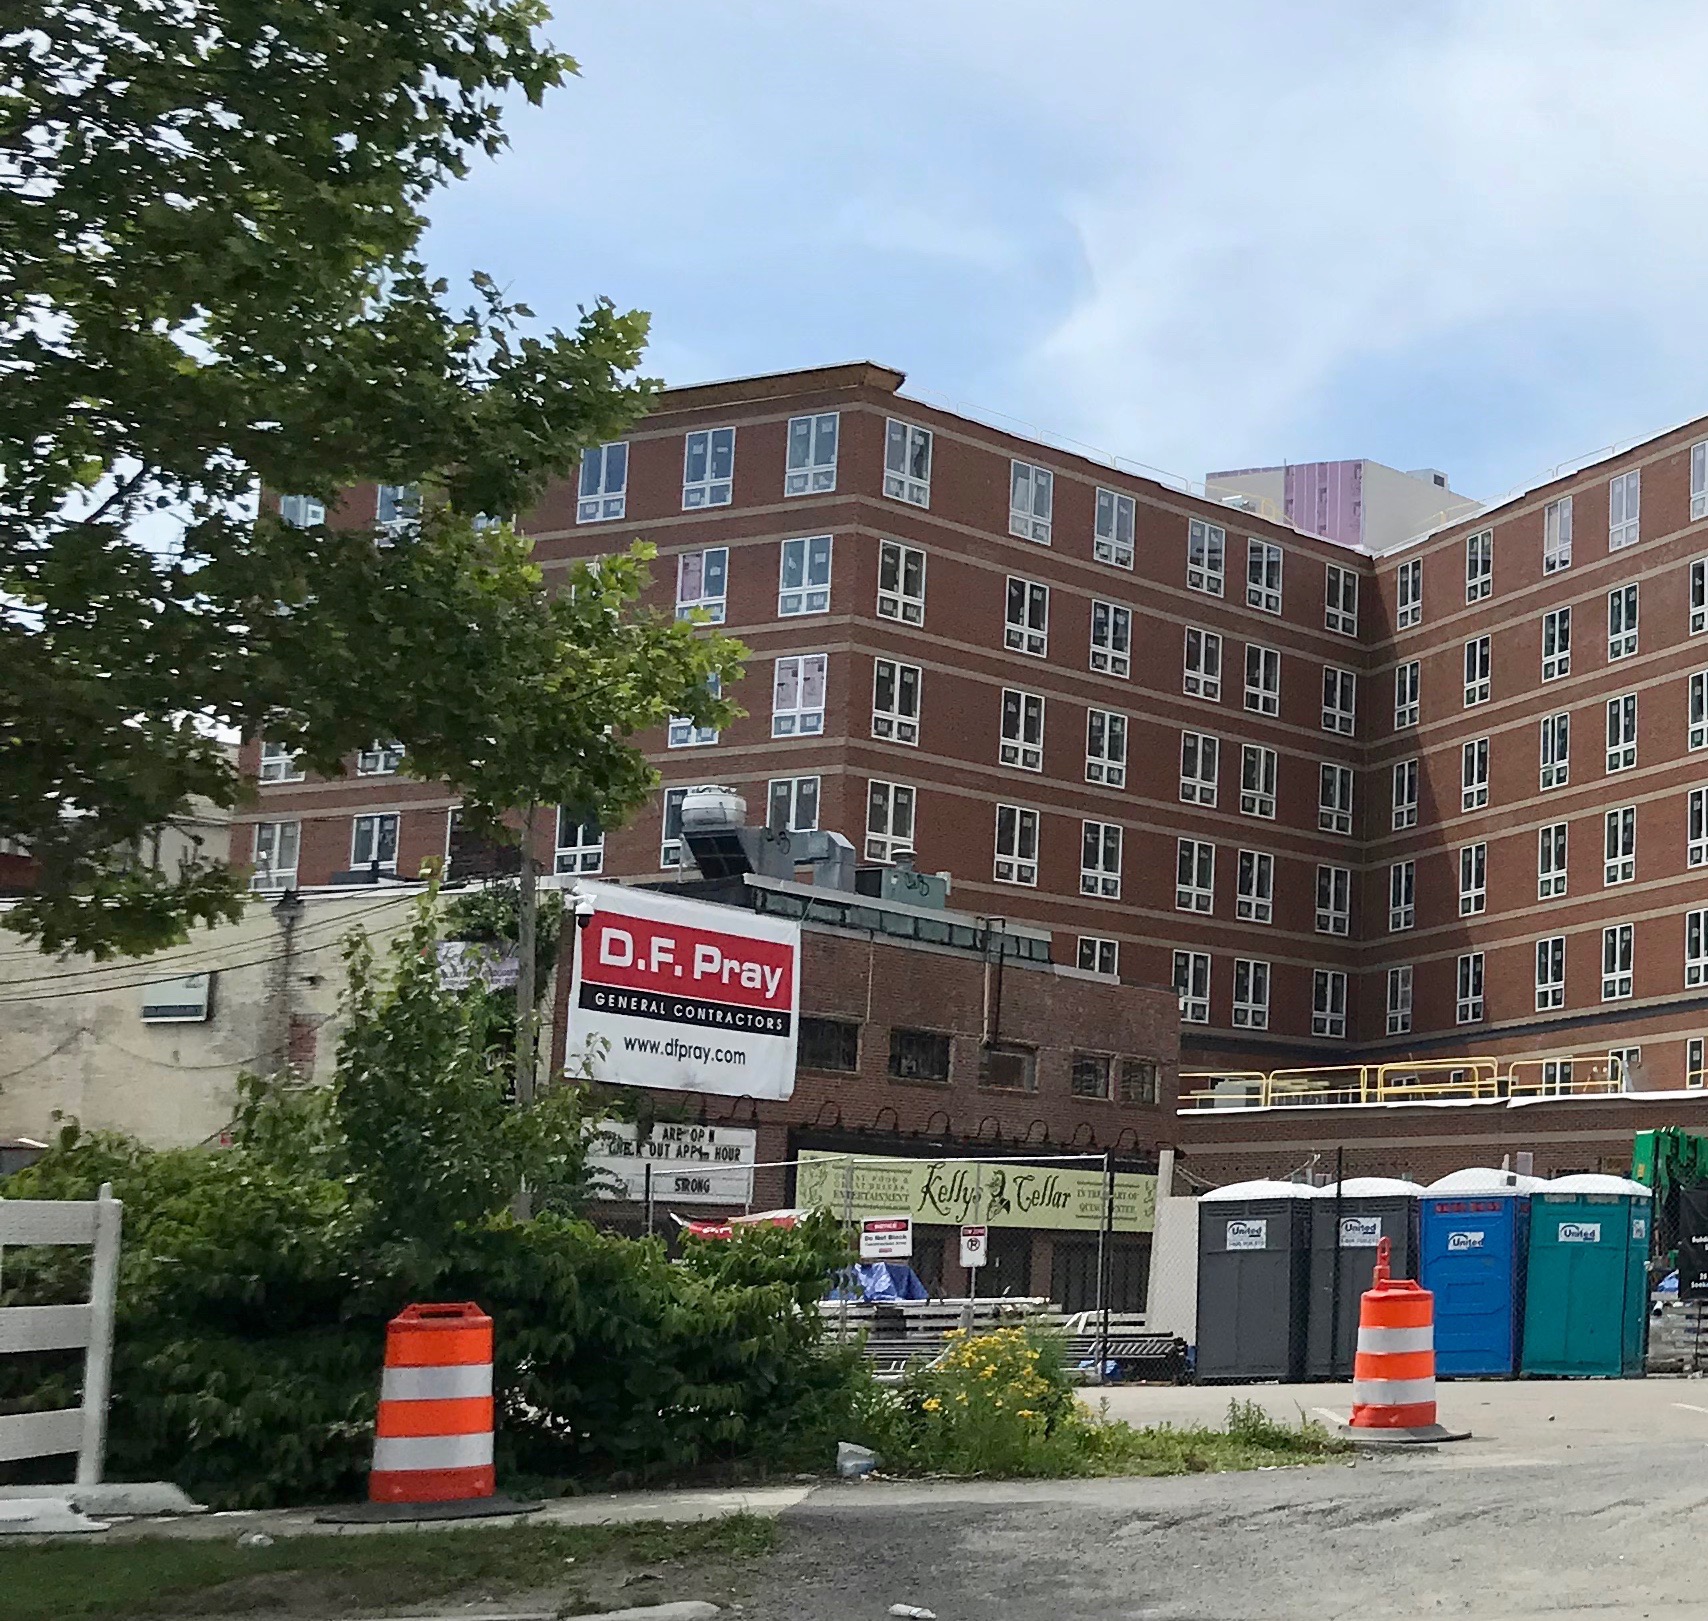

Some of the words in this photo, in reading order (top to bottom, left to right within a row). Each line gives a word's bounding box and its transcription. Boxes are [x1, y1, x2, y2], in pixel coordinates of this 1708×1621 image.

[600, 926, 682, 977] D.F.
[693, 943, 783, 999] Pray
[595, 992, 666, 1015] GENERAL
[673, 1004, 783, 1031] CONTRACTORS
[624, 1036, 746, 1065] www.dfpray.com
[662, 1126, 682, 1141] ARE
[649, 1142, 670, 1158] OUT
[714, 1146, 741, 1162] HOUR
[1013, 1174, 1071, 1212] Cellar
[1232, 1226, 1262, 1236] United
[1345, 1223, 1377, 1232] United
[1563, 1228, 1596, 1239] United
